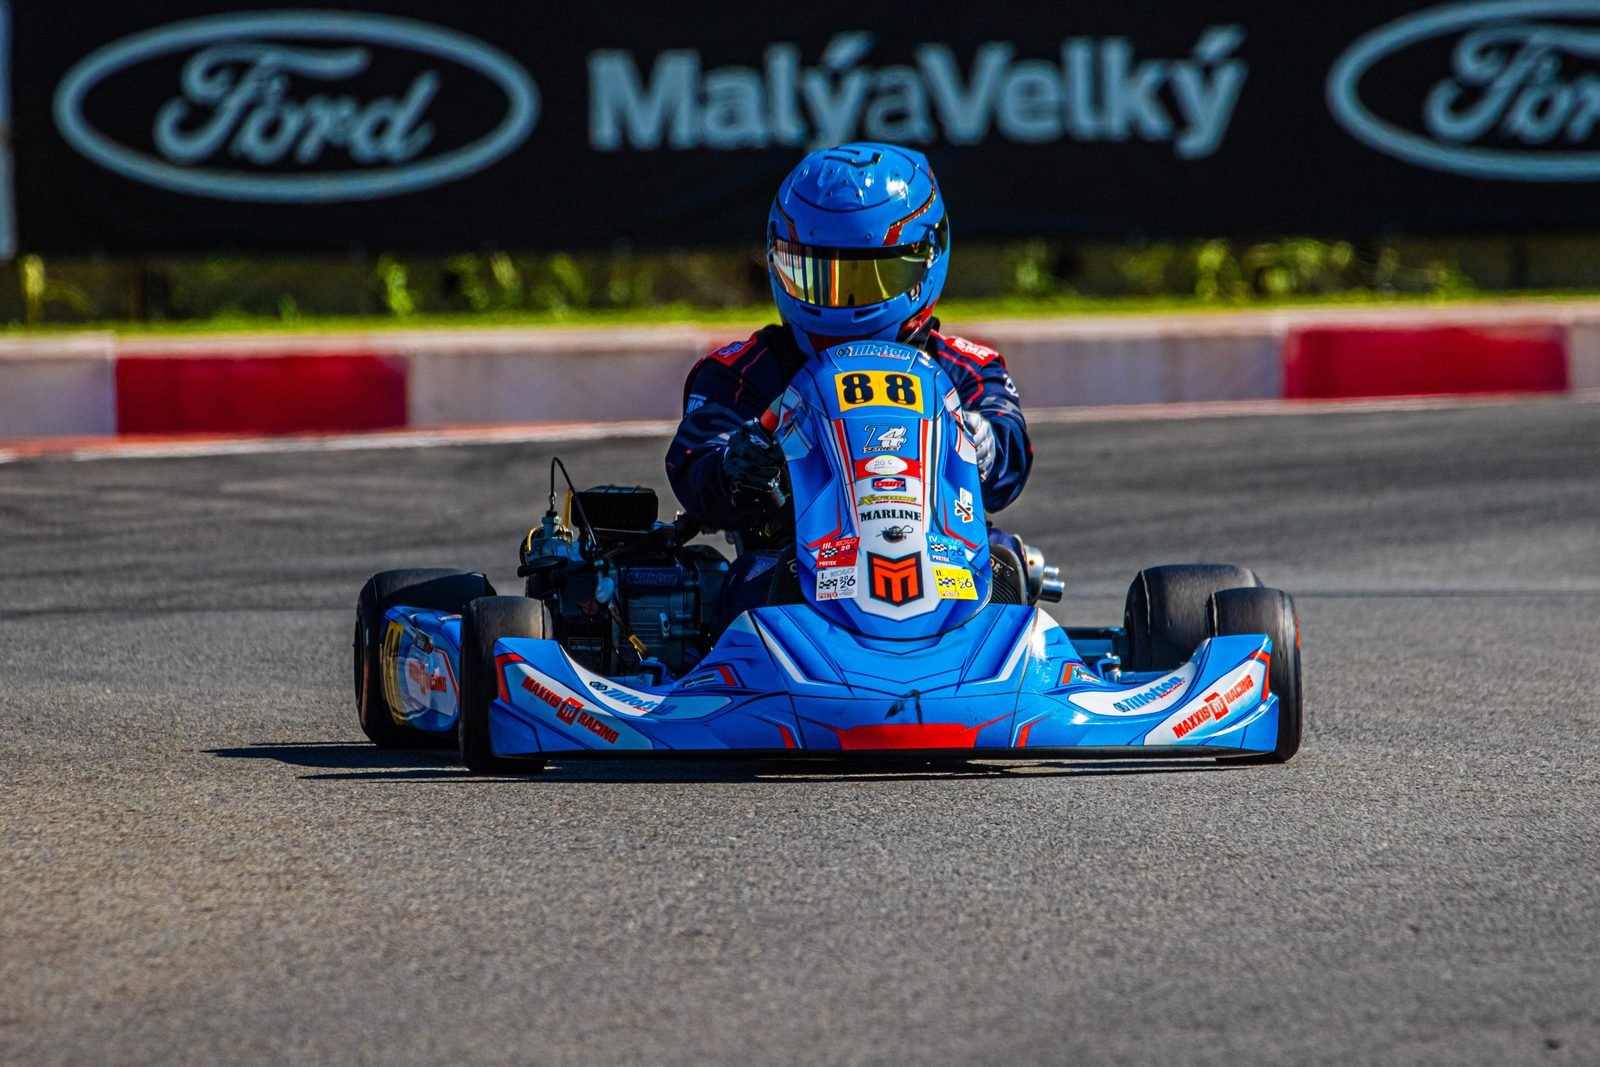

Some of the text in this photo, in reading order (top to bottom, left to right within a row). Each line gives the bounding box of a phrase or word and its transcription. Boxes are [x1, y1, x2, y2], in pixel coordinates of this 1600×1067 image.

[153, 43, 440, 166] Ford
[588, 25, 1247, 158] MalýaVelký
[1424, 25, 1600, 143] For
[860, 509, 922, 522] MARLINE
[522, 675, 564, 710] MAXXIS
[577, 712, 621, 745] RACING
[1121, 676, 1182, 710] Tillotson
[1172, 704, 1212, 739] MAXXIS
[1224, 674, 1255, 704] RACING
